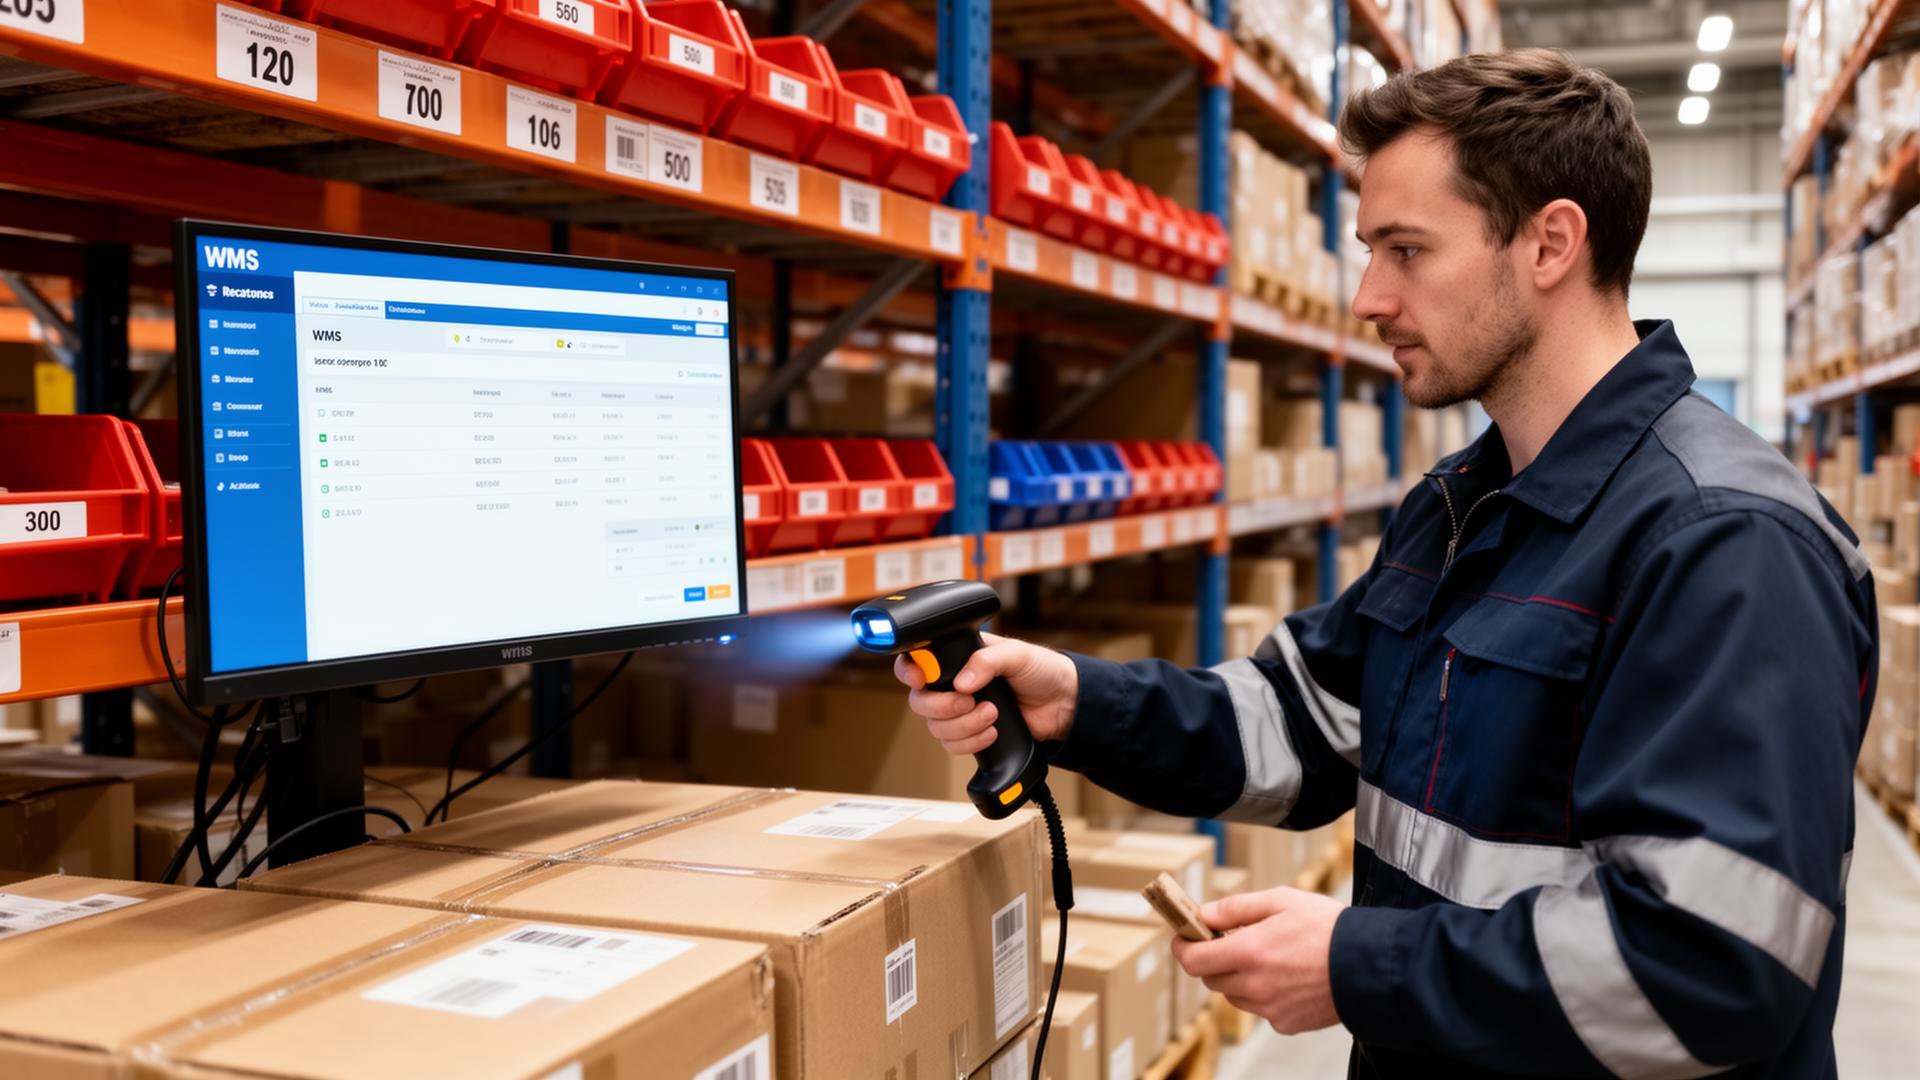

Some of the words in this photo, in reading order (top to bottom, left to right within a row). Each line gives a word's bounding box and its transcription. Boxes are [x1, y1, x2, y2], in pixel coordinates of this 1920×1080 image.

[247, 42, 294, 86] 120
[405, 83, 442, 121] 700
[528, 114, 561, 150] 106
[664, 151, 691, 182] 500
[204, 245, 260, 271] WMS
[312, 330, 342, 342] WMS
[25, 510, 61, 532] 300
